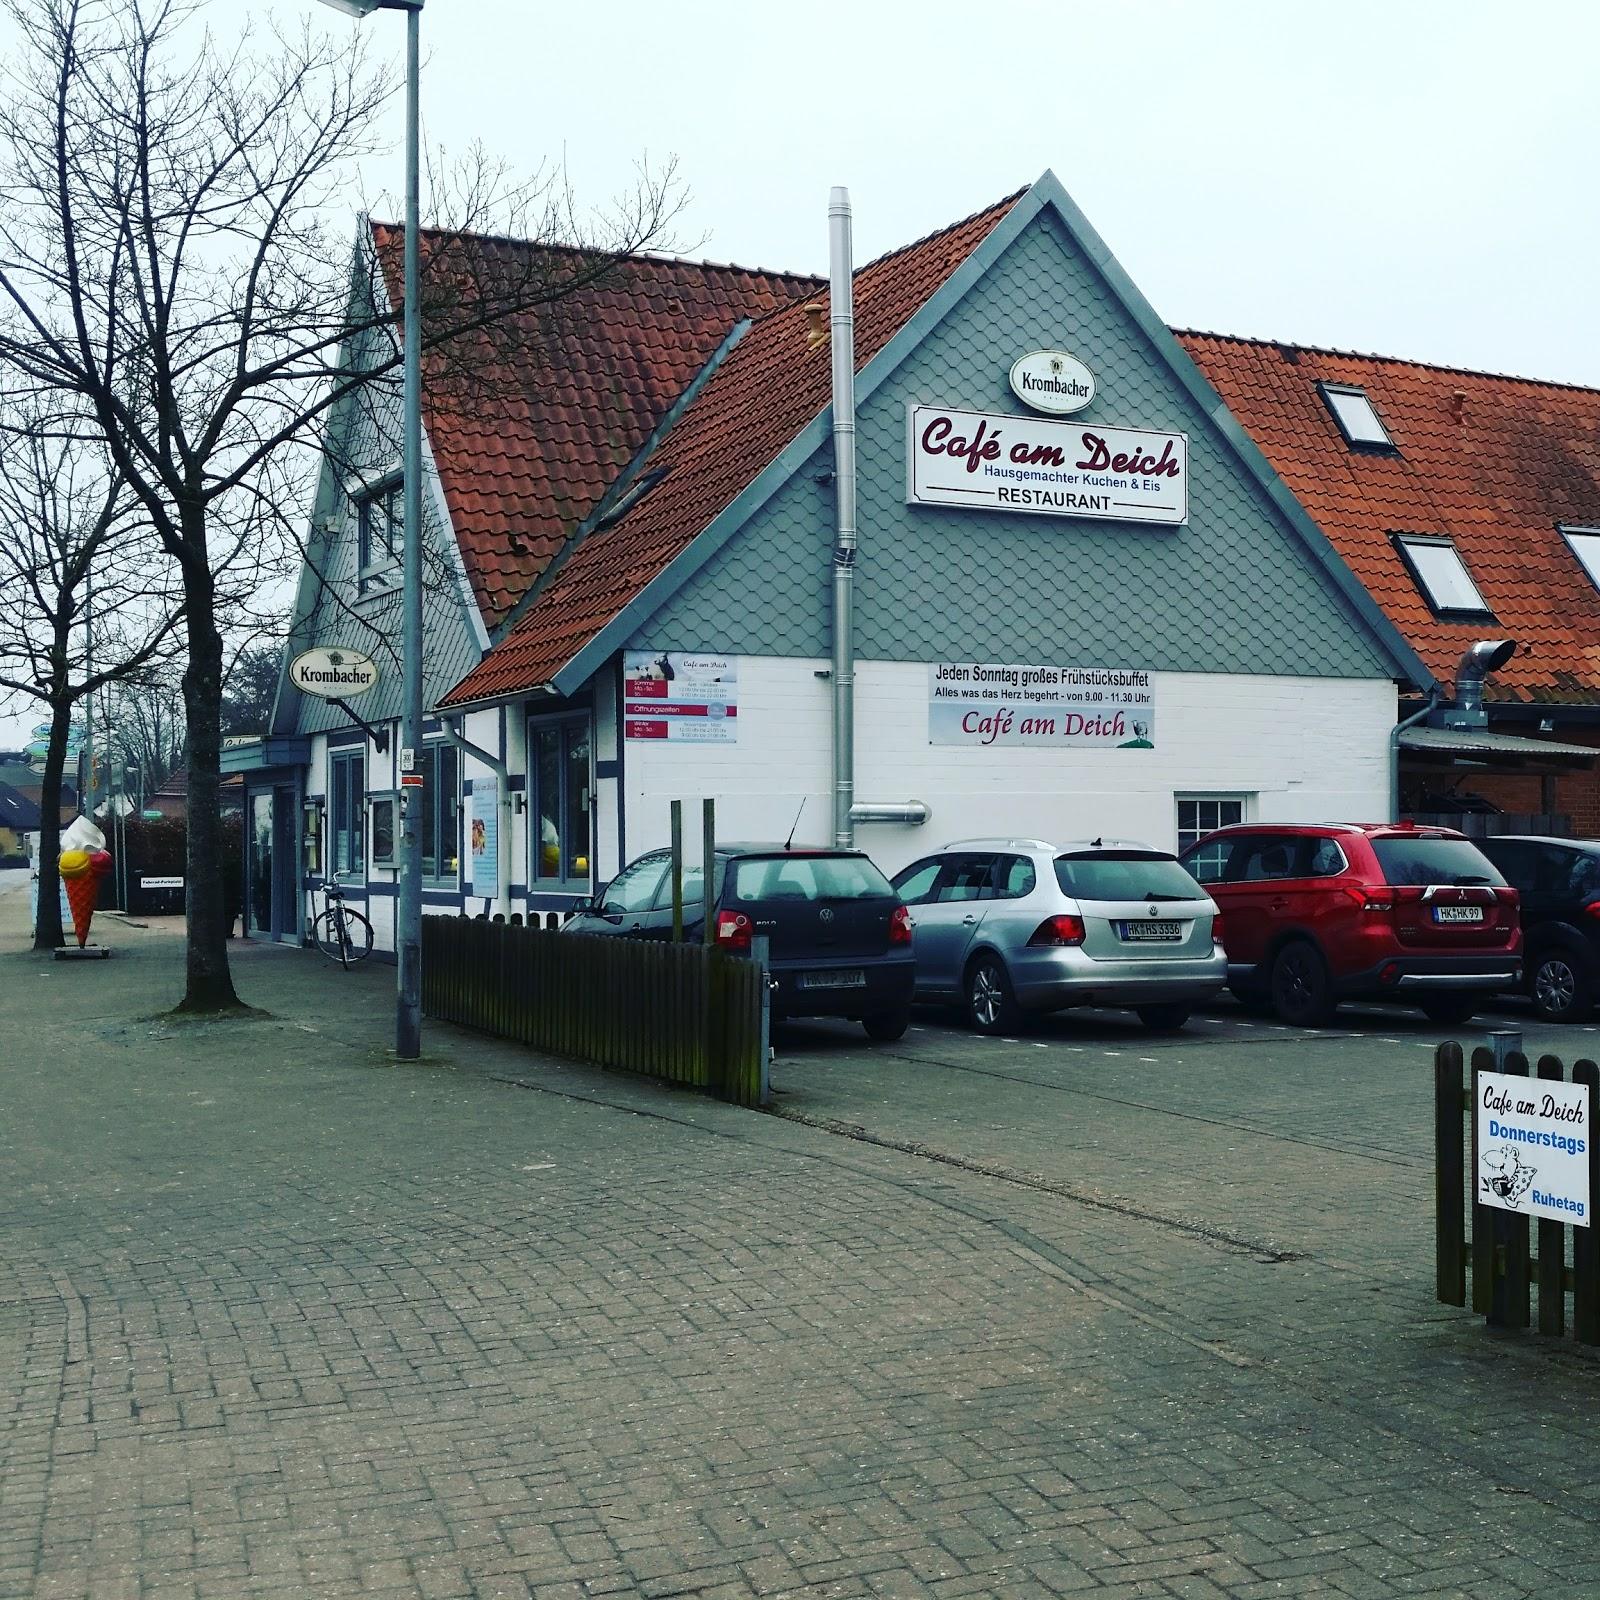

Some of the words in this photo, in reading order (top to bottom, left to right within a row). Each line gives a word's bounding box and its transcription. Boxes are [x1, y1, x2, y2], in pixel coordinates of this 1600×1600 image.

[1022, 372, 1090, 398] Krombacher
[922, 416, 1002, 473] Café
[1010, 442, 1064, 467] am
[1075, 432, 1180, 478] Deich
[985, 465, 1079, 485] Hausgemachter
[1082, 473, 1127, 489] Kuchen
[1130, 478, 1139, 490] &
[1143, 480, 1161, 492] Eis
[998, 487, 1110, 511] RESTAURANT
[301, 666, 371, 684] Krombacher
[936, 664, 969, 681] Jeden
[972, 665, 1019, 687] Sonntag
[1022, 668, 1058, 687] großes
[1061, 669, 1149, 687] Frühstücksbuffet
[935, 687, 959, 698] Alles
[961, 690, 979, 698] was
[982, 688, 998, 699] das
[1001, 689, 1022, 700] Herz
[1024, 690, 1059, 702] begehrt
[1067, 693, 1083, 701] von
[1085, 692, 1103, 702] 9.00
[1110, 693, 1133, 703] 11.30
[1135, 693, 1151, 703] Uhr
[962, 707, 1015, 745] Café
[1020, 717, 1055, 735] am
[1064, 711, 1125, 736] Deich
[1440, 908, 1452, 918] HK
[1457, 908, 1469, 919] HK
[1469, 908, 1479, 919] 99
[1128, 923, 1140, 934] HK
[1146, 923, 1157, 934] HS
[1159, 923, 1179, 934] 3336
[1483, 1086, 1513, 1116] Cafe
[1516, 1102, 1536, 1116] am
[1540, 1094, 1584, 1124] Deich
[1490, 1120, 1586, 1155] Donnerstags
[1532, 1190, 1585, 1217] Ruhetag
